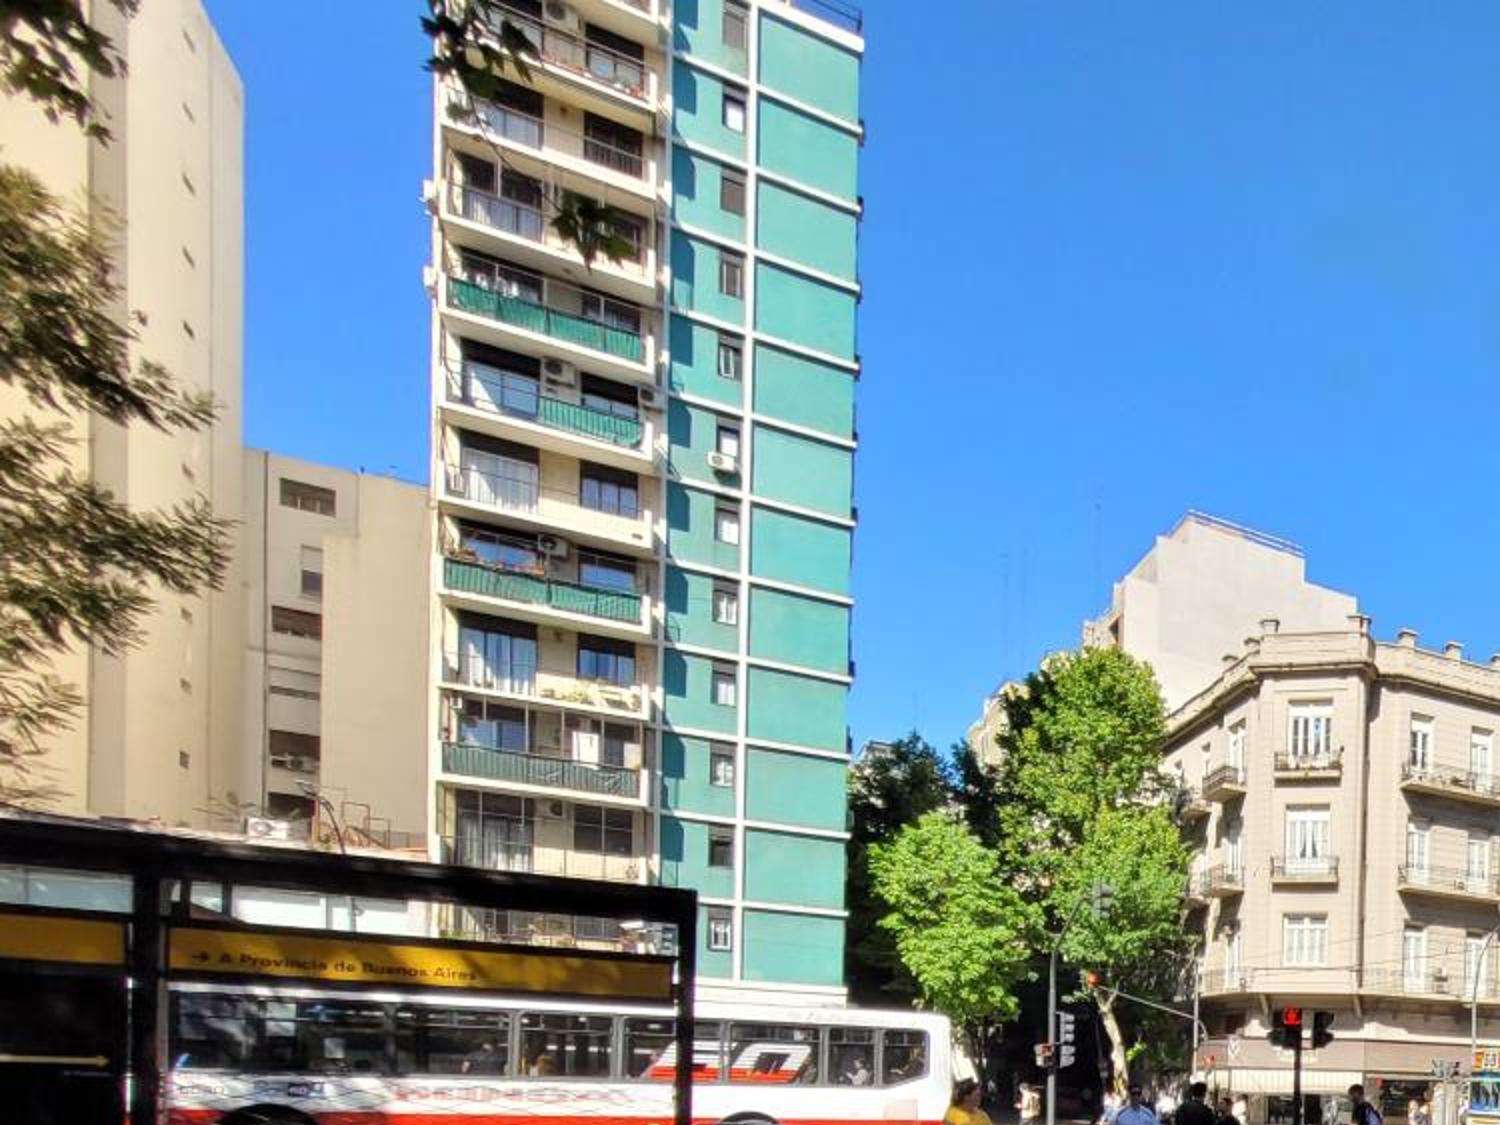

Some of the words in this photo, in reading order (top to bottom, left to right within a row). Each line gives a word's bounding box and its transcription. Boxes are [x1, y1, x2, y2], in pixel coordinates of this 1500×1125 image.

[219, 952, 232, 965] A
[239, 953, 328, 972] Provincia
[334, 961, 354, 973] de
[362, 961, 428, 978] Buenos
[433, 967, 477, 982] Aires
